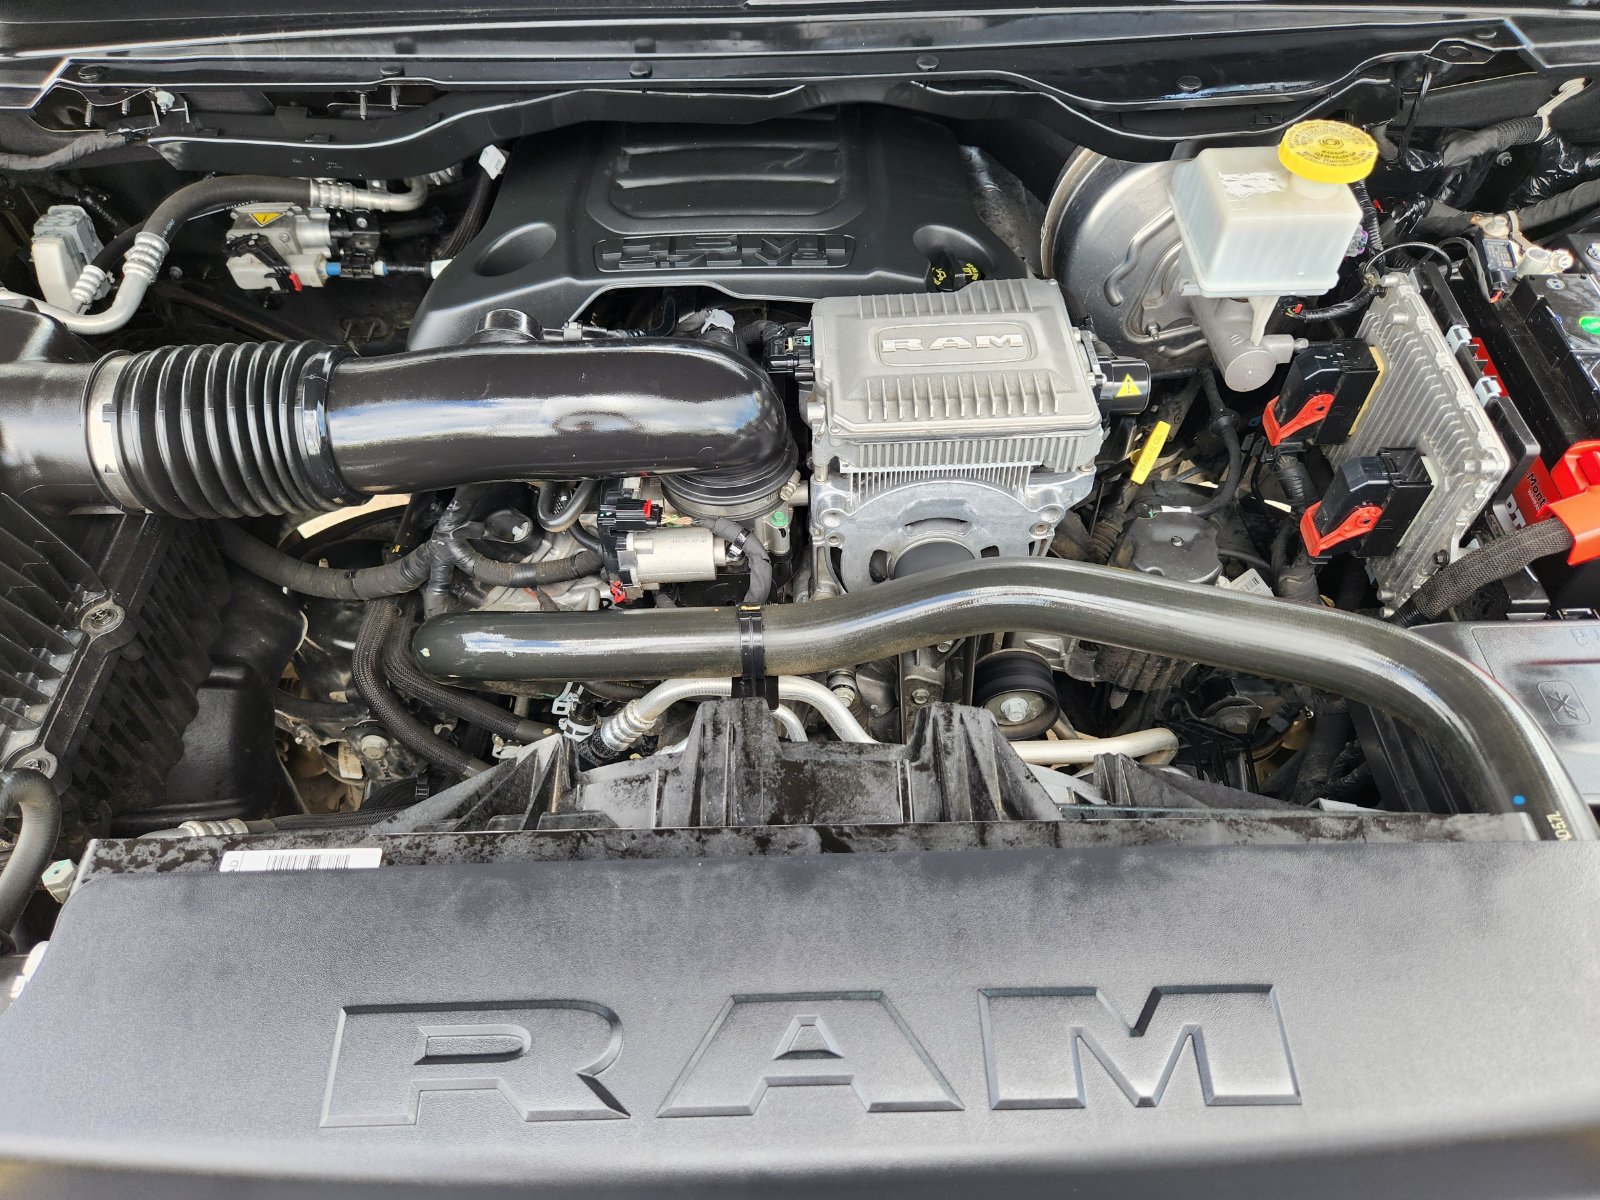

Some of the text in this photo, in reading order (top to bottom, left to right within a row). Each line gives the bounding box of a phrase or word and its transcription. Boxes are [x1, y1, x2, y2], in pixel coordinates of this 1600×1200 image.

[602, 234, 846, 268] HEMI
[882, 334, 1025, 353] RAM
[1526, 472, 1547, 506] -Mont
[318, 984, 1303, 1128] RAM
